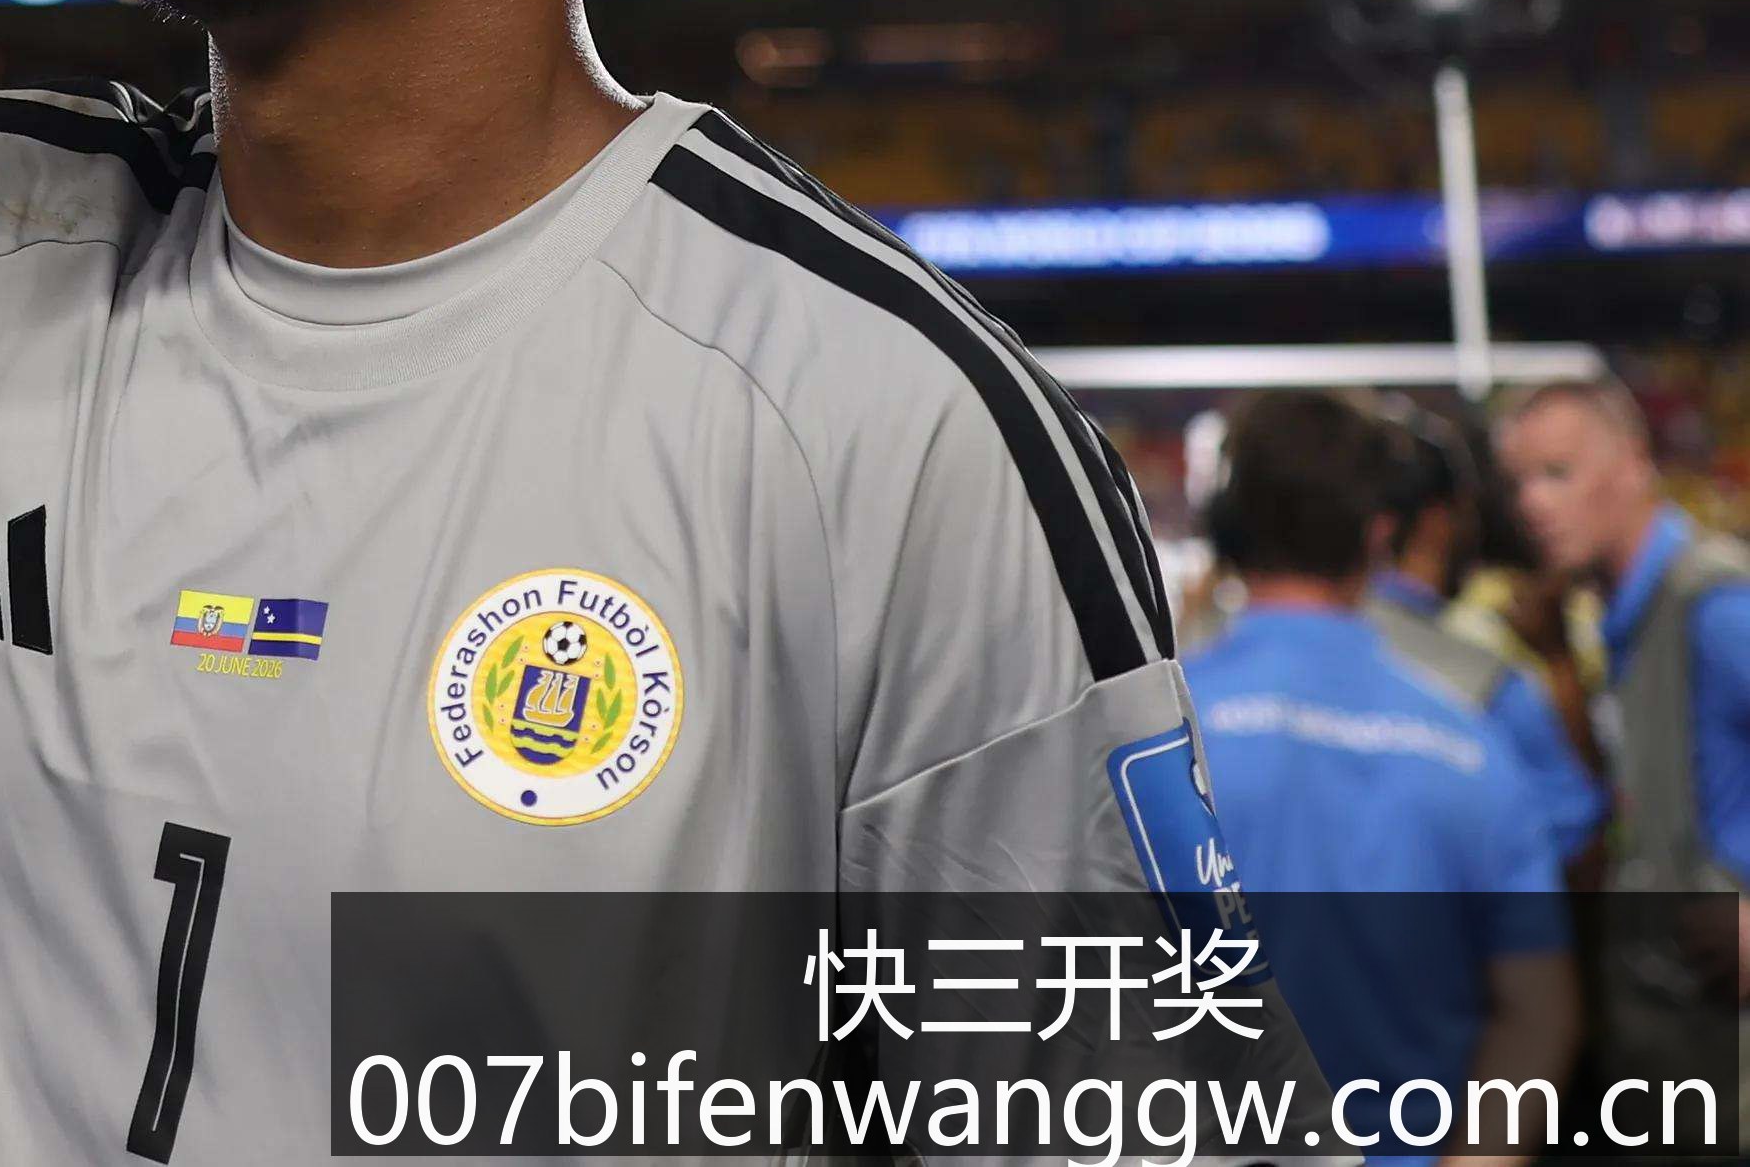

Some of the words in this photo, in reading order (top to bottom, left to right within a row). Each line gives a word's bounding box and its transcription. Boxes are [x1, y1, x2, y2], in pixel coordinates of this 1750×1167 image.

[197, 653, 216, 673] 20
[215, 655, 252, 676] JUNE
[251, 658, 283, 679] 2026
[441, 588, 542, 767] Federashon
[557, 580, 659, 657] Futbòl
[596, 671, 671, 790] Kòrsou
[126, 822, 232, 1165] 1
